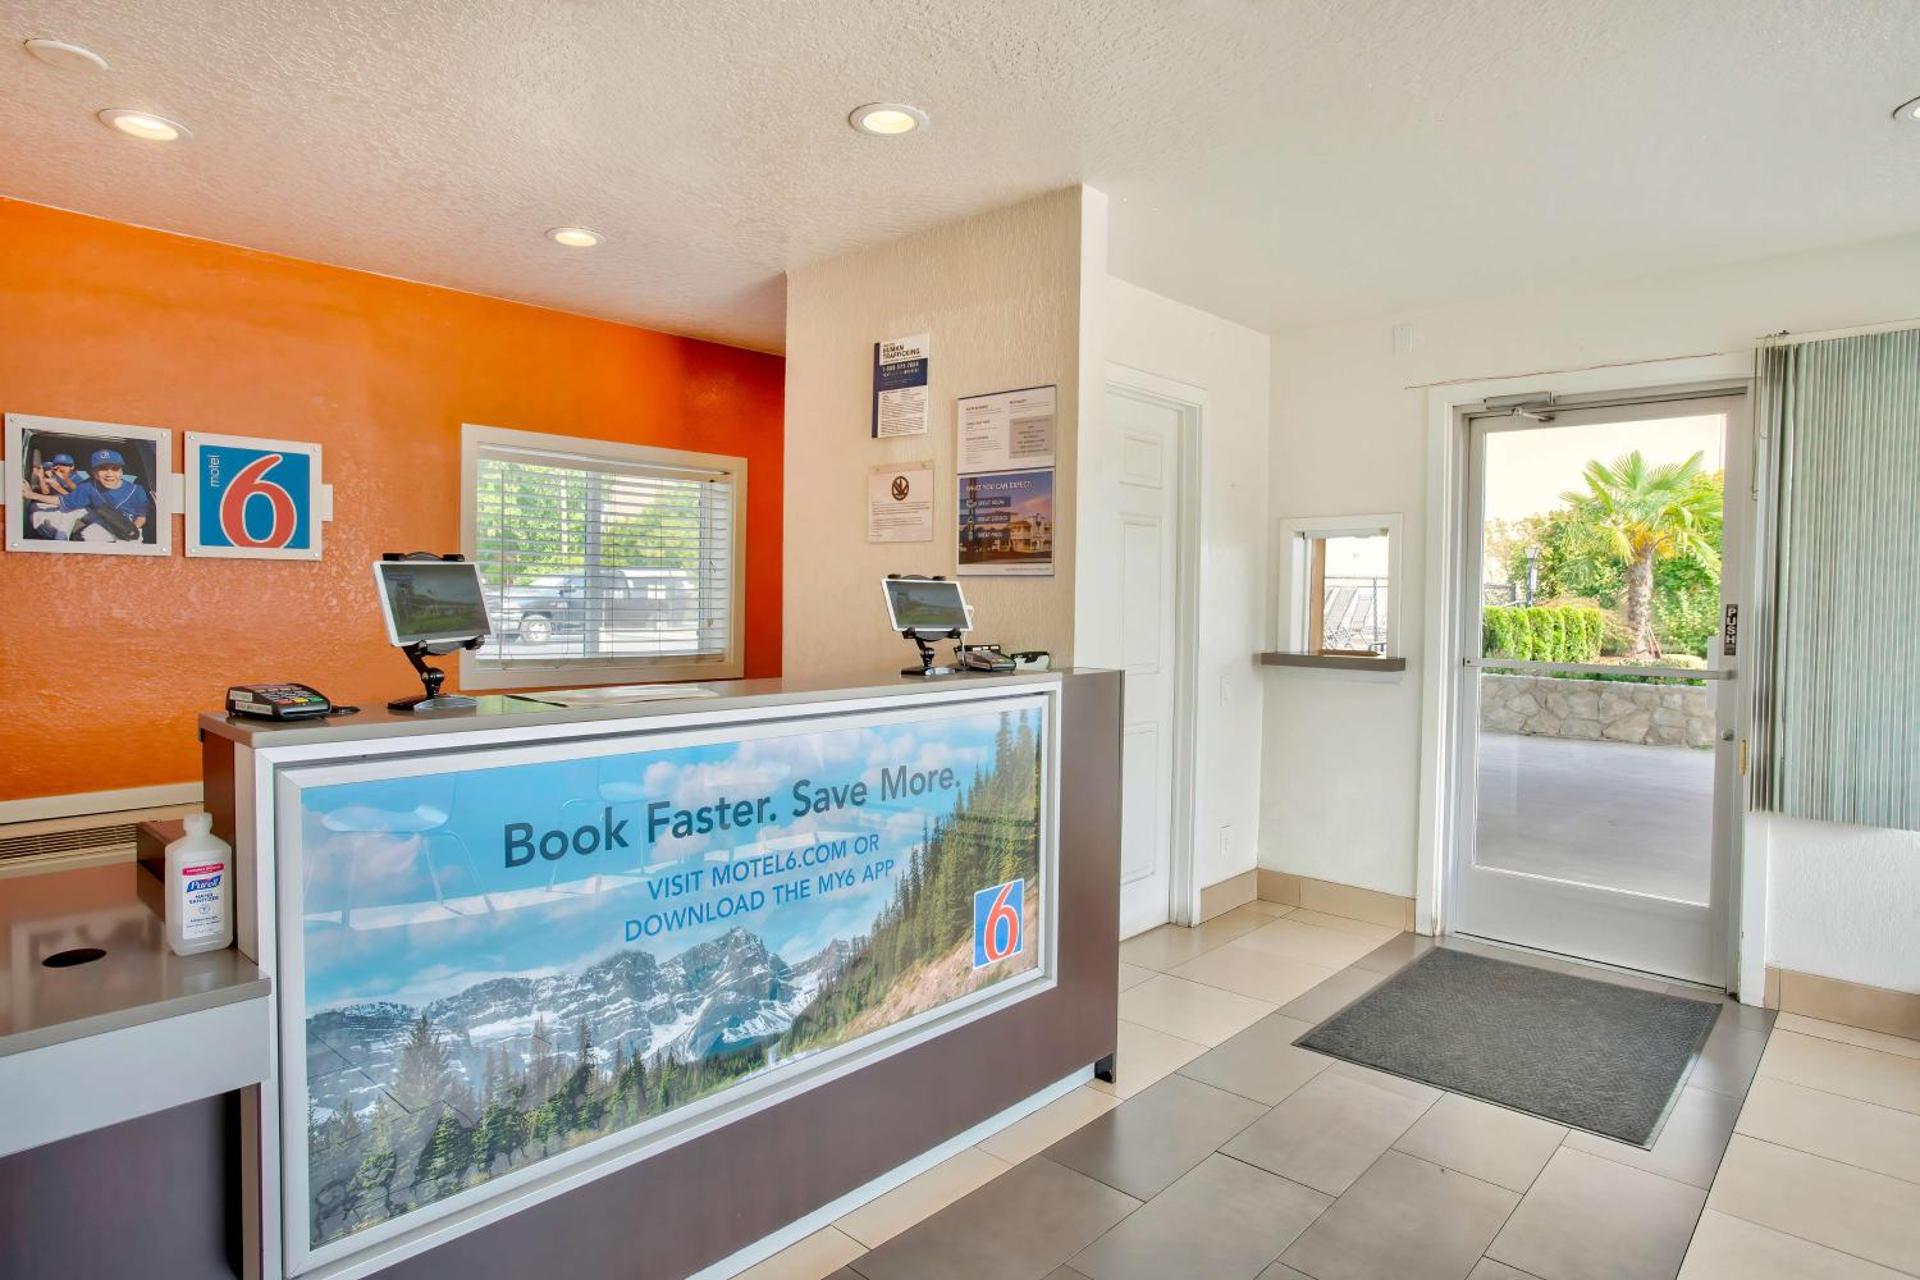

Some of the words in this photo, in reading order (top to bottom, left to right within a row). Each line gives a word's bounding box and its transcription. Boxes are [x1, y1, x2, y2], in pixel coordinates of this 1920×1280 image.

[882, 347, 921, 360] TRAFFICKING
[208, 454, 220, 488] motel
[219, 453, 298, 549] 6
[1726, 607, 1737, 644] PUSH
[504, 806, 629, 869] Book
[648, 796, 777, 843] Faster.
[792, 779, 868, 818] Save
[881, 765, 961, 801] More.
[625, 890, 765, 942] DOWNLOAD
[773, 878, 811, 905] THE
[818, 868, 856, 895] MY6
[862, 858, 895, 882] APP
[647, 870, 704, 900] VISIT
[712, 840, 847, 887] MOTEL6.COM
[854, 833, 880, 855] OR
[983, 881, 1020, 963] 6
